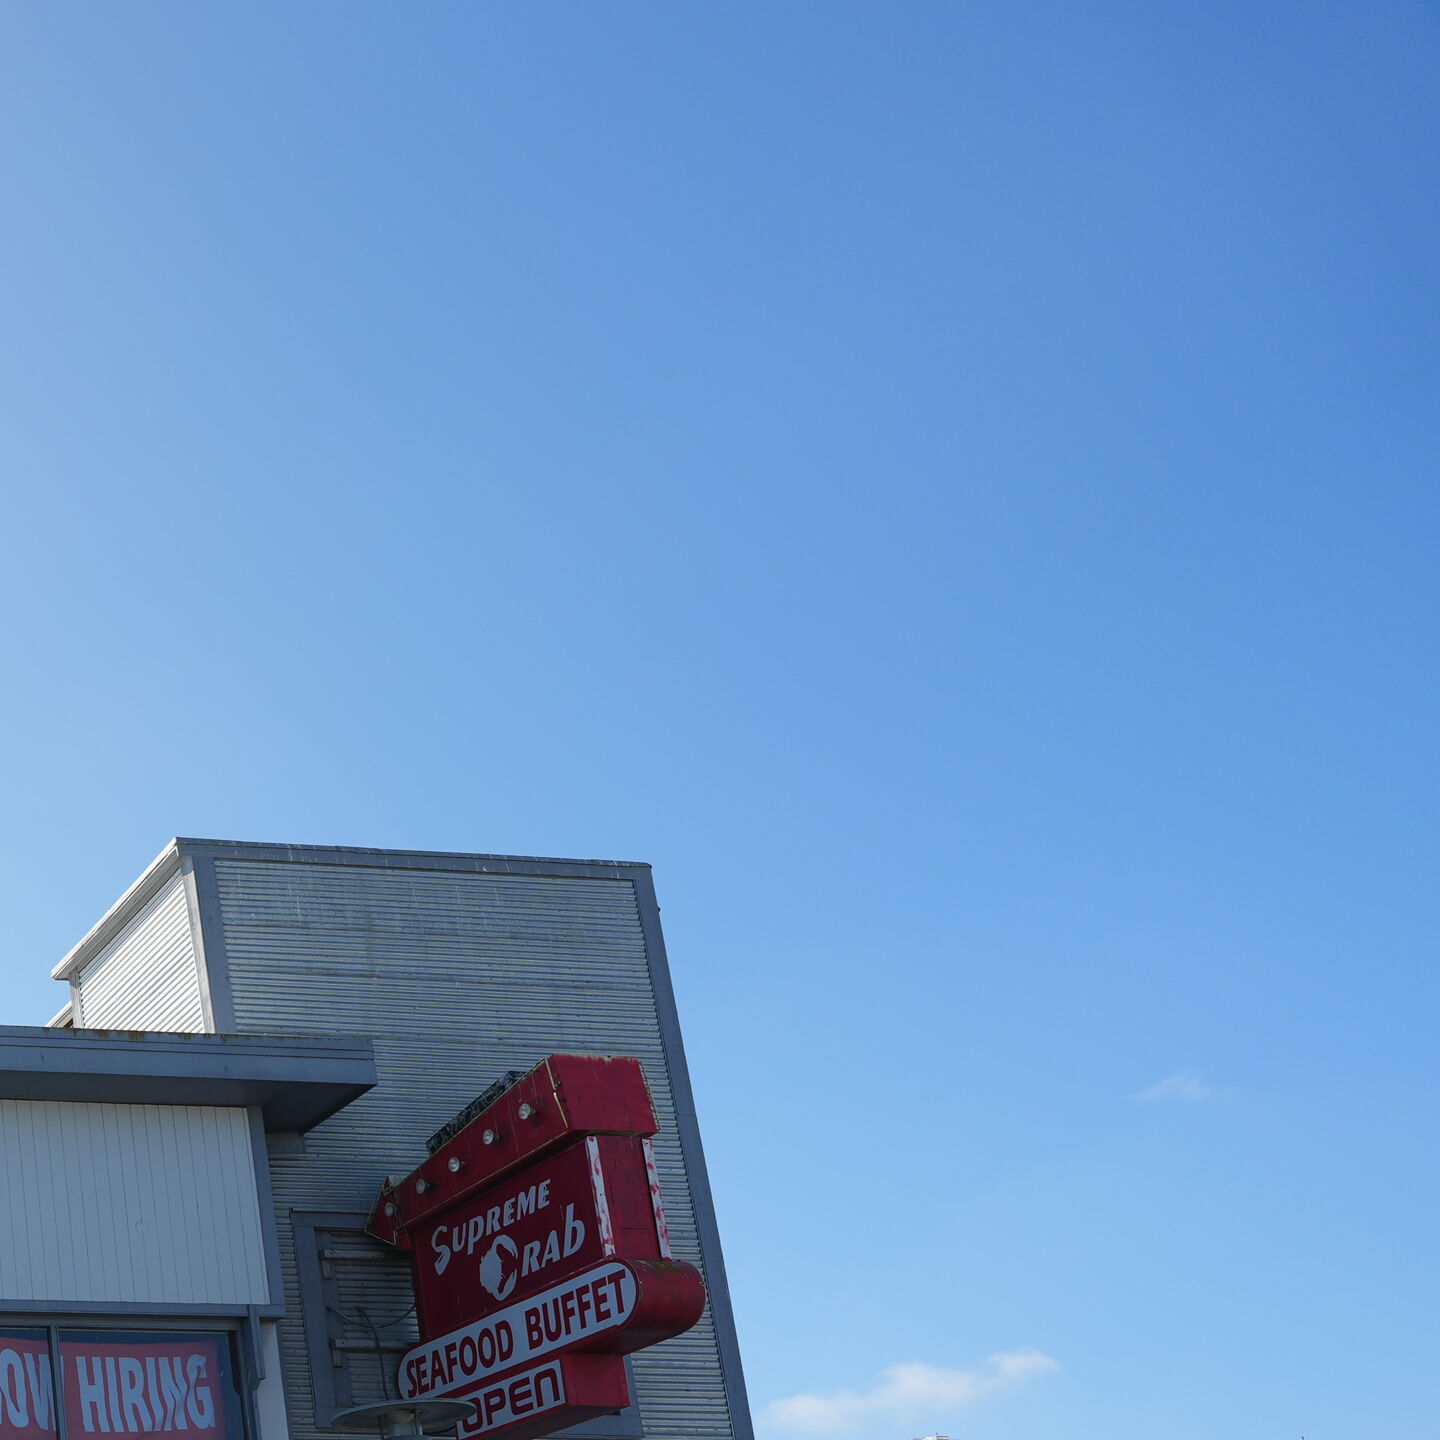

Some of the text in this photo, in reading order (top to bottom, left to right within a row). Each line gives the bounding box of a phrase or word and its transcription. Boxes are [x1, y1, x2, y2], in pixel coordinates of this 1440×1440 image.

[405, 1268, 627, 1400] SEAFOOD BUFFET
[76, 1354, 216, 1432] HIRING
[461, 1366, 561, 1434] OPEN
